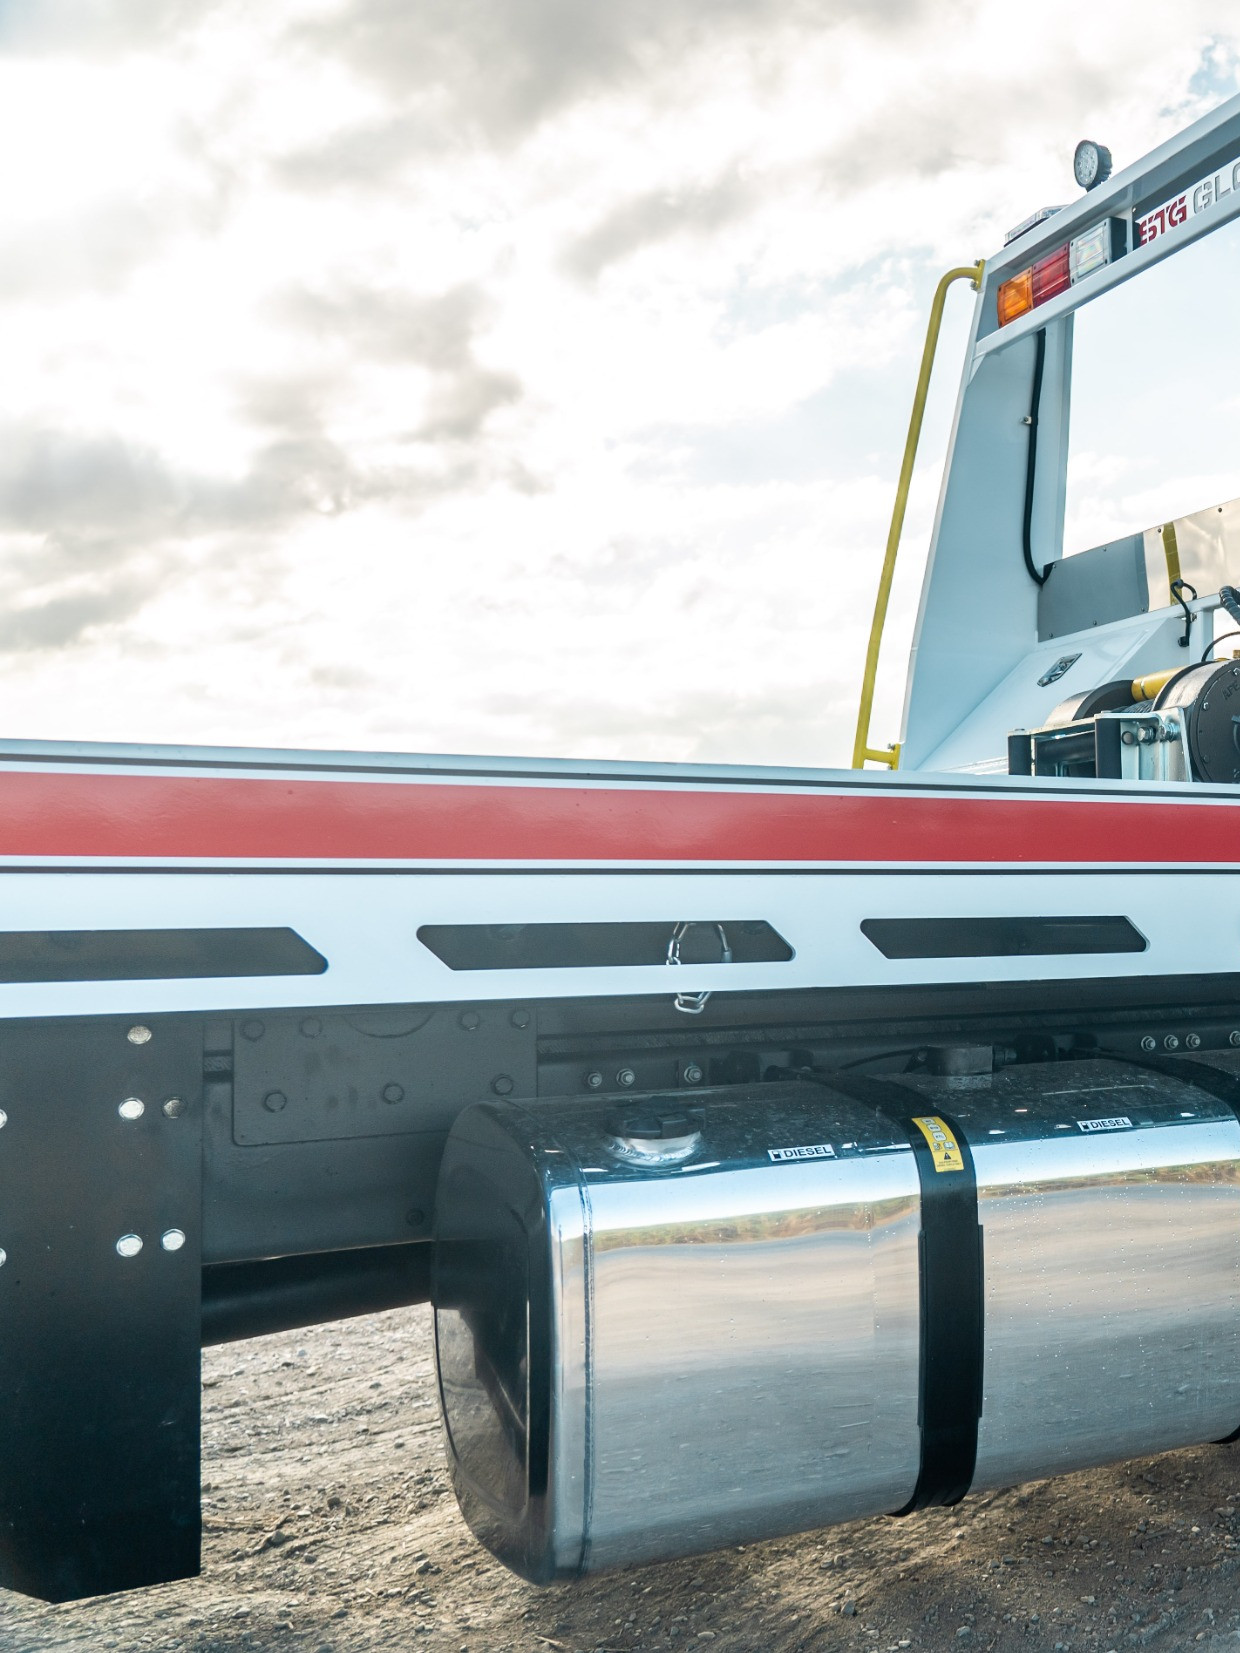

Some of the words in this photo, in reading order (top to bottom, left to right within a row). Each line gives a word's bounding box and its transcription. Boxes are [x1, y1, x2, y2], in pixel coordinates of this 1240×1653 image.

[1138, 194, 1187, 247] STG
[1089, 1118, 1130, 1129] DIESEL
[783, 1146, 832, 1158] DIESEL
